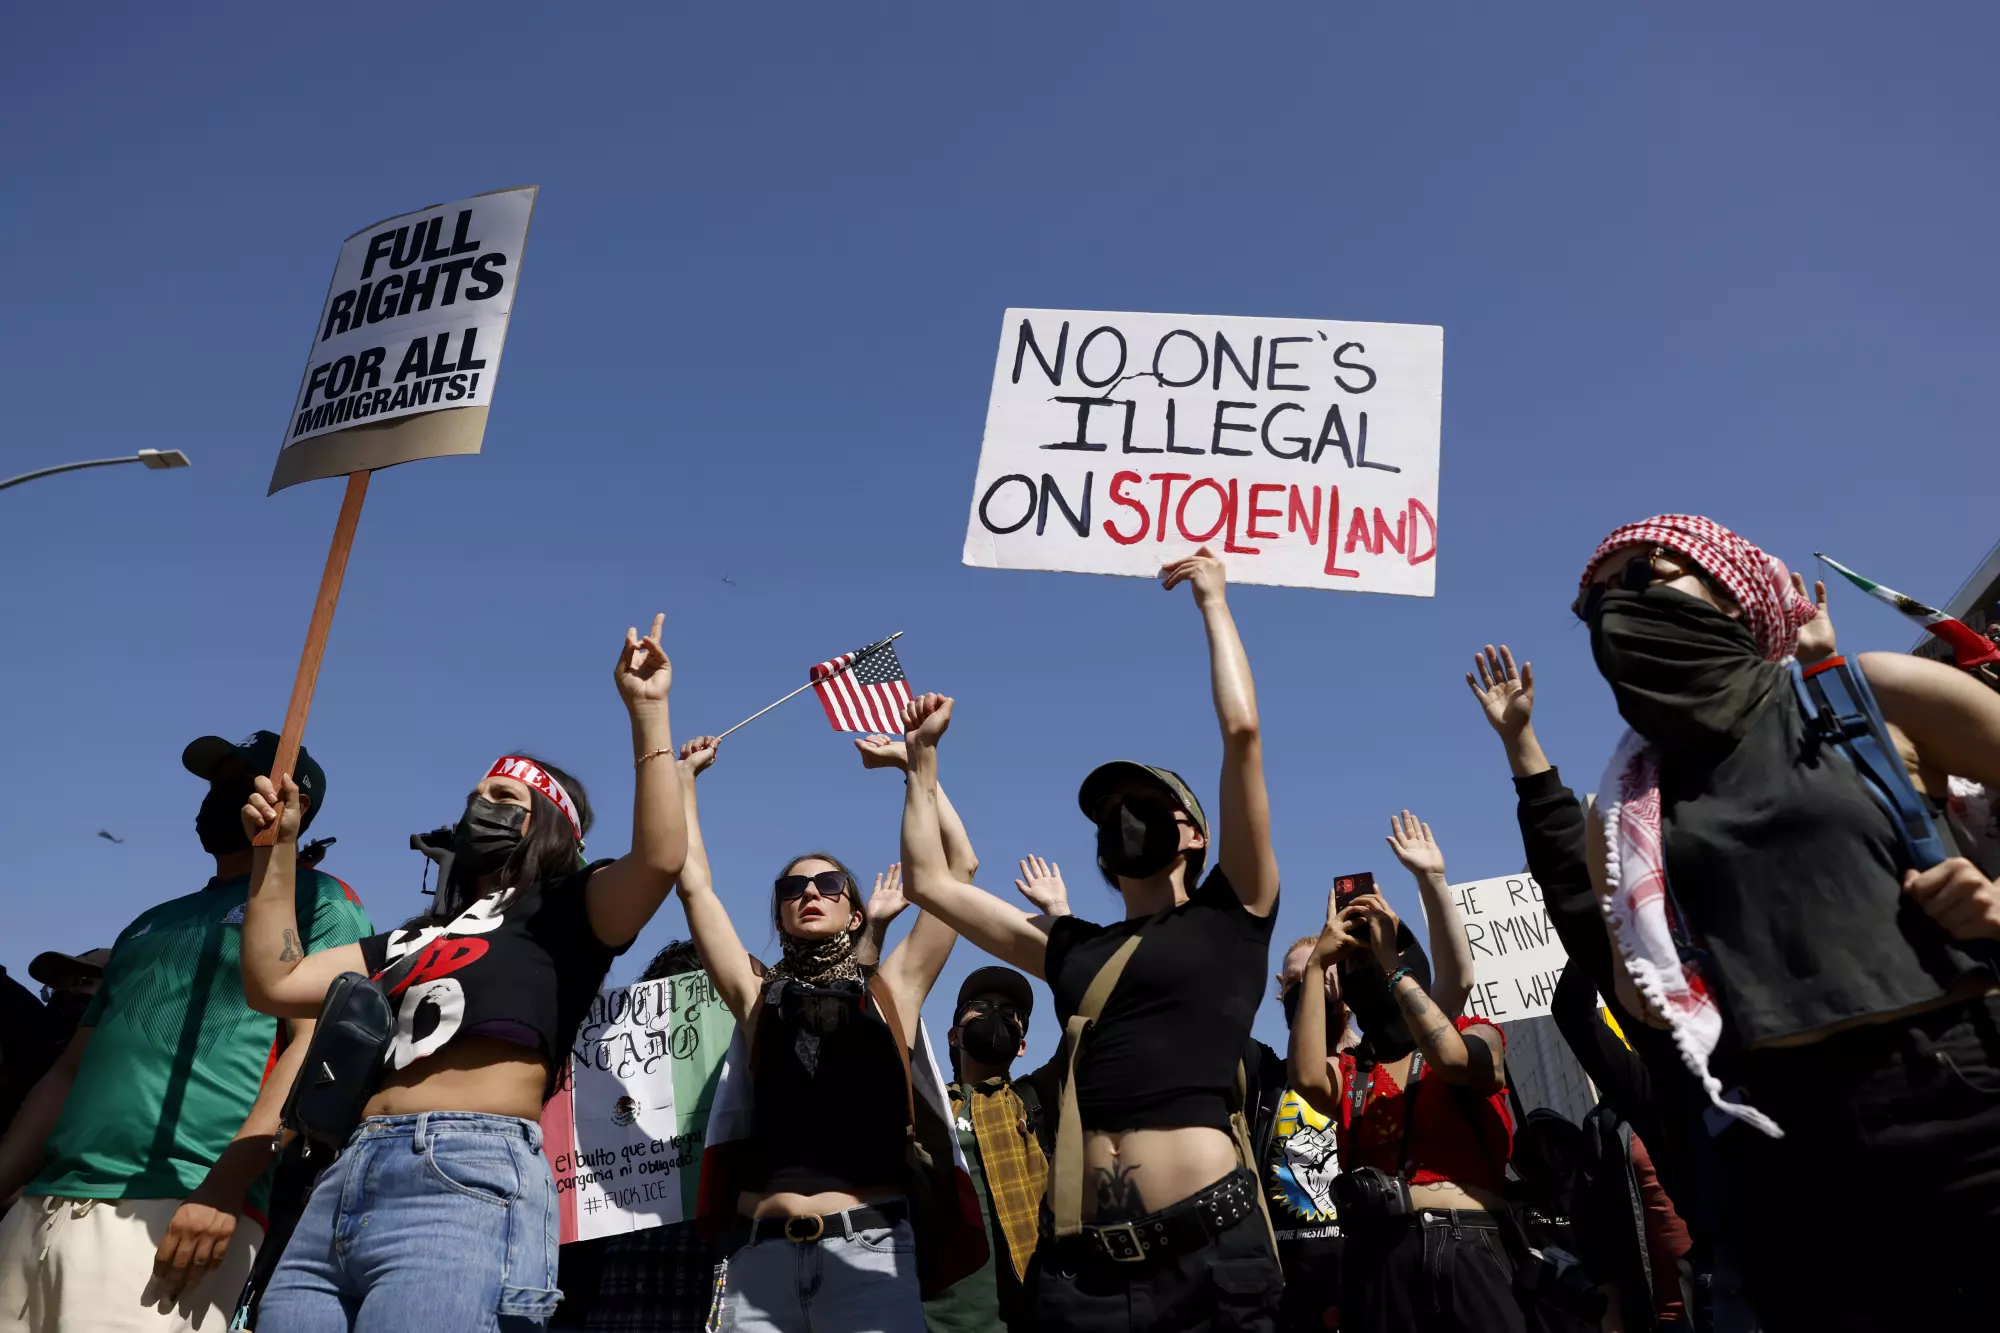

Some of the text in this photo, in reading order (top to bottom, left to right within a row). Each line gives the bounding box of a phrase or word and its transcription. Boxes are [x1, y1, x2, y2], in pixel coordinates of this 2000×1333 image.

[360, 209, 480, 280] FULL
[321, 252, 506, 342] RIGHTS
[301, 328, 486, 410] FOR ALL
[1012, 319, 1127, 388] NO
[293, 373, 480, 438] IMMIGRANTS!
[1039, 397, 1400, 473] ILLEGAL
[979, 470, 1436, 578] ON STOLEN LAND
[496, 758, 566, 806] MEX
[1451, 877, 1544, 915] HE RE
[1464, 908, 1555, 960] RIMINA
[1462, 981, 1506, 1017] HE
[1355, 1090, 1363, 1107] EOS
[555, 1130, 702, 1173] el bulto que el legal
[556, 1168, 613, 1193] cargaria
[620, 1165, 632, 1177] ni
[1275, 1229, 1296, 1240] MPIRE
[1296, 1226, 1340, 1240] WRESTLING
